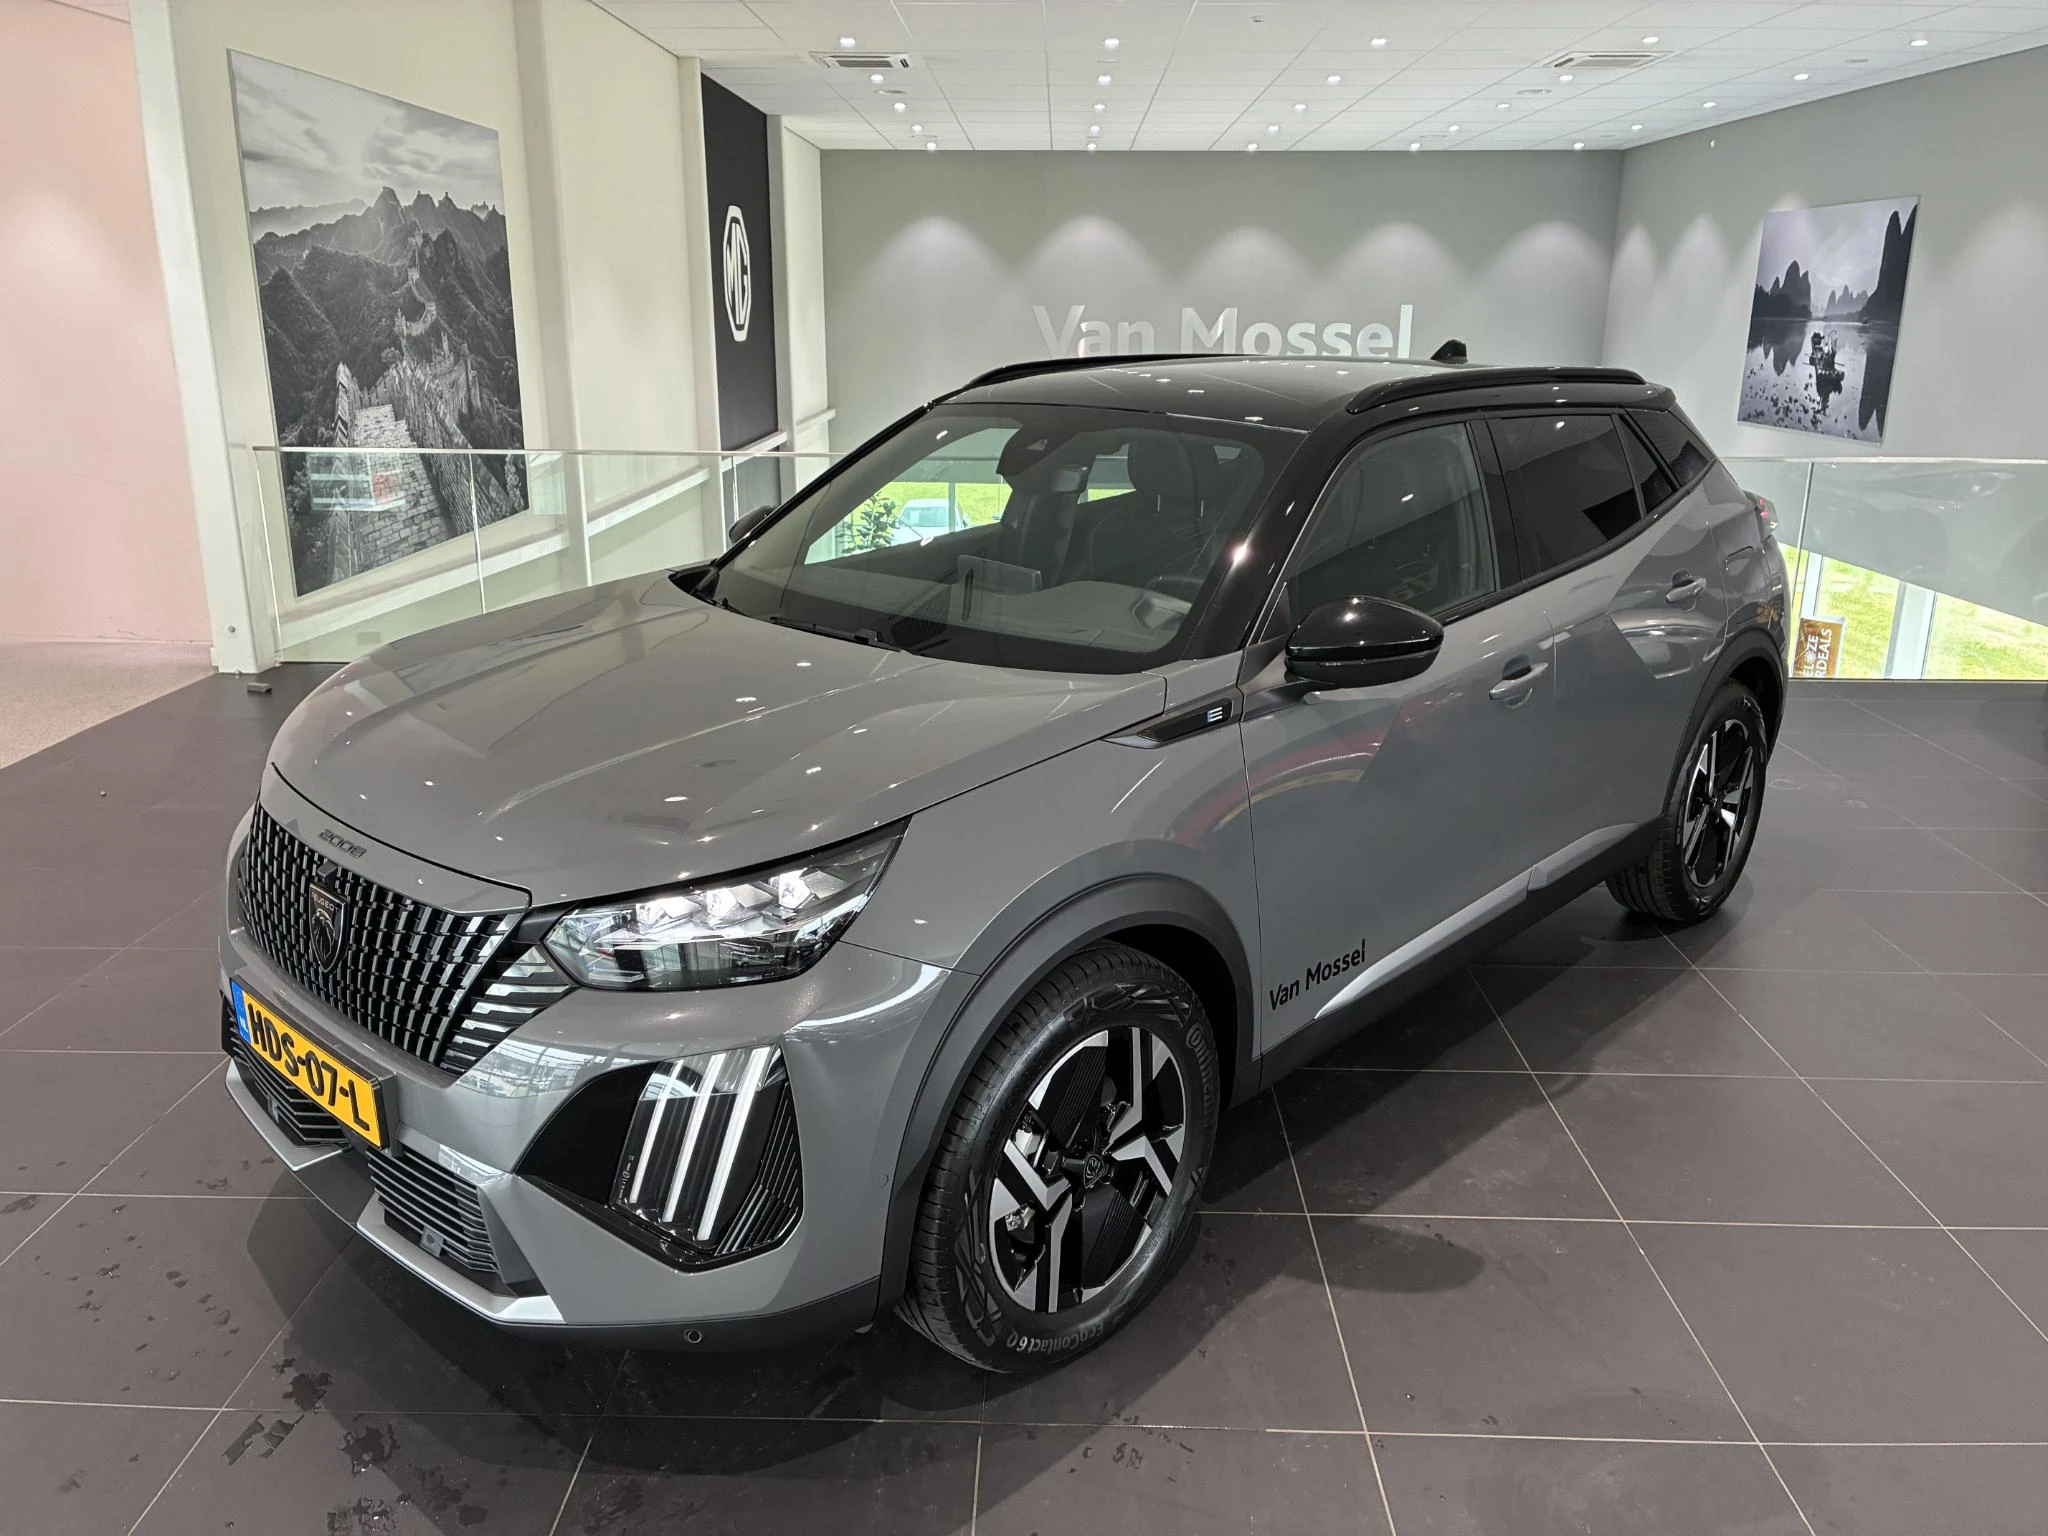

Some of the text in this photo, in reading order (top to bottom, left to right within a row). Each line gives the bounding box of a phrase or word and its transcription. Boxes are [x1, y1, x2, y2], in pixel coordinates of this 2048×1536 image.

[725, 220, 749, 326] MG
[1032, 304, 1414, 359] Van Mossel
[319, 829, 367, 858] 2008
[311, 891, 340, 914] PEUGEOT
[1269, 938, 1366, 1011] Van Mossel
[239, 1017, 249, 1033] NL
[247, 1002, 370, 1132] HDS-07-L
